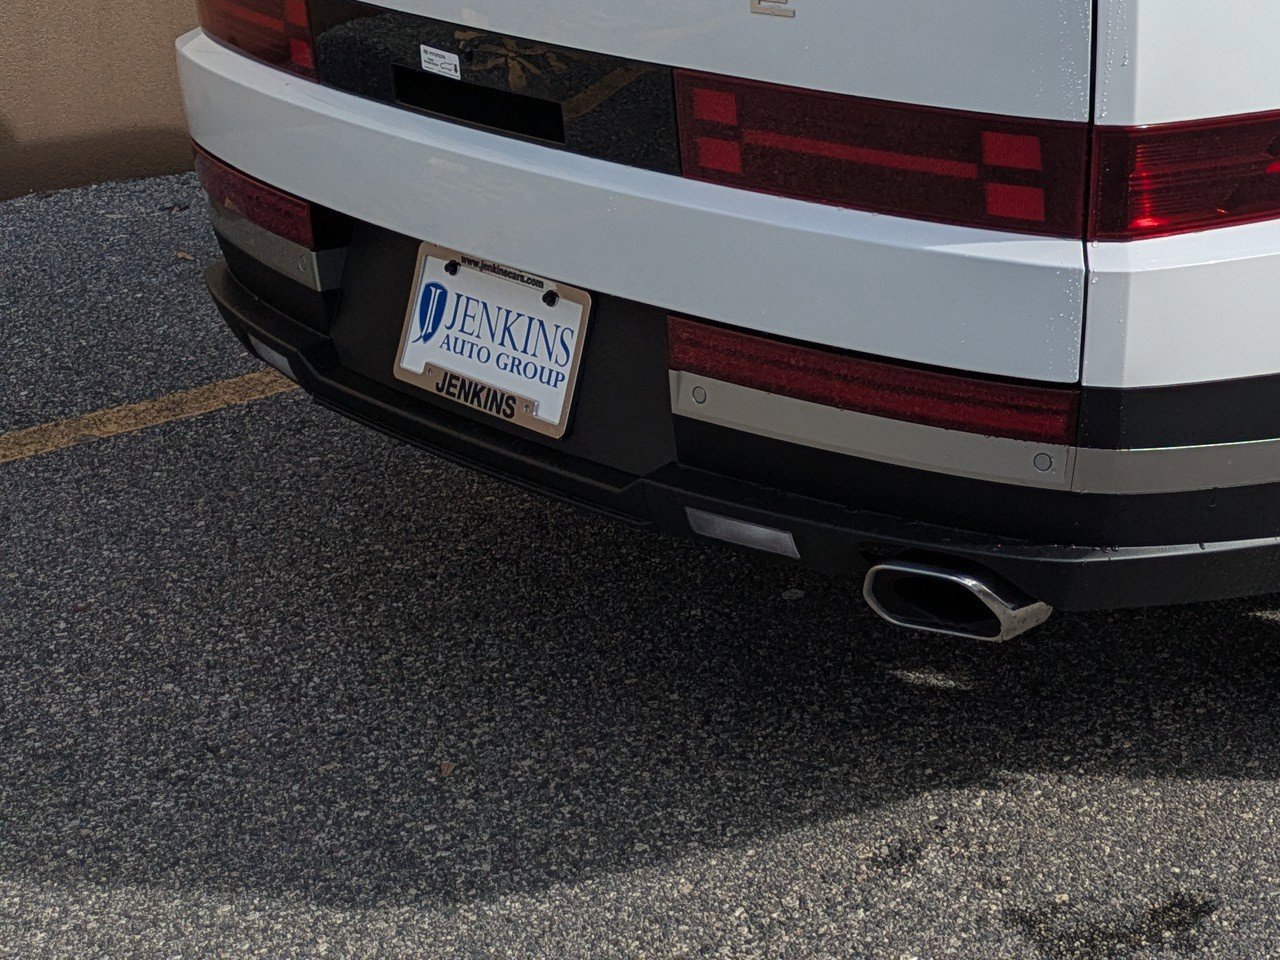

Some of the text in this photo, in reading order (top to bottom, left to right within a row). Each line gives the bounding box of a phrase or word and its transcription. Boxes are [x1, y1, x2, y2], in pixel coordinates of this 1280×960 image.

[461, 256, 544, 288] www.jenkinscars.com
[444, 292, 575, 368] JENKINS
[439, 333, 566, 390] AUTO GROUP
[435, 372, 517, 418] JENKINS
